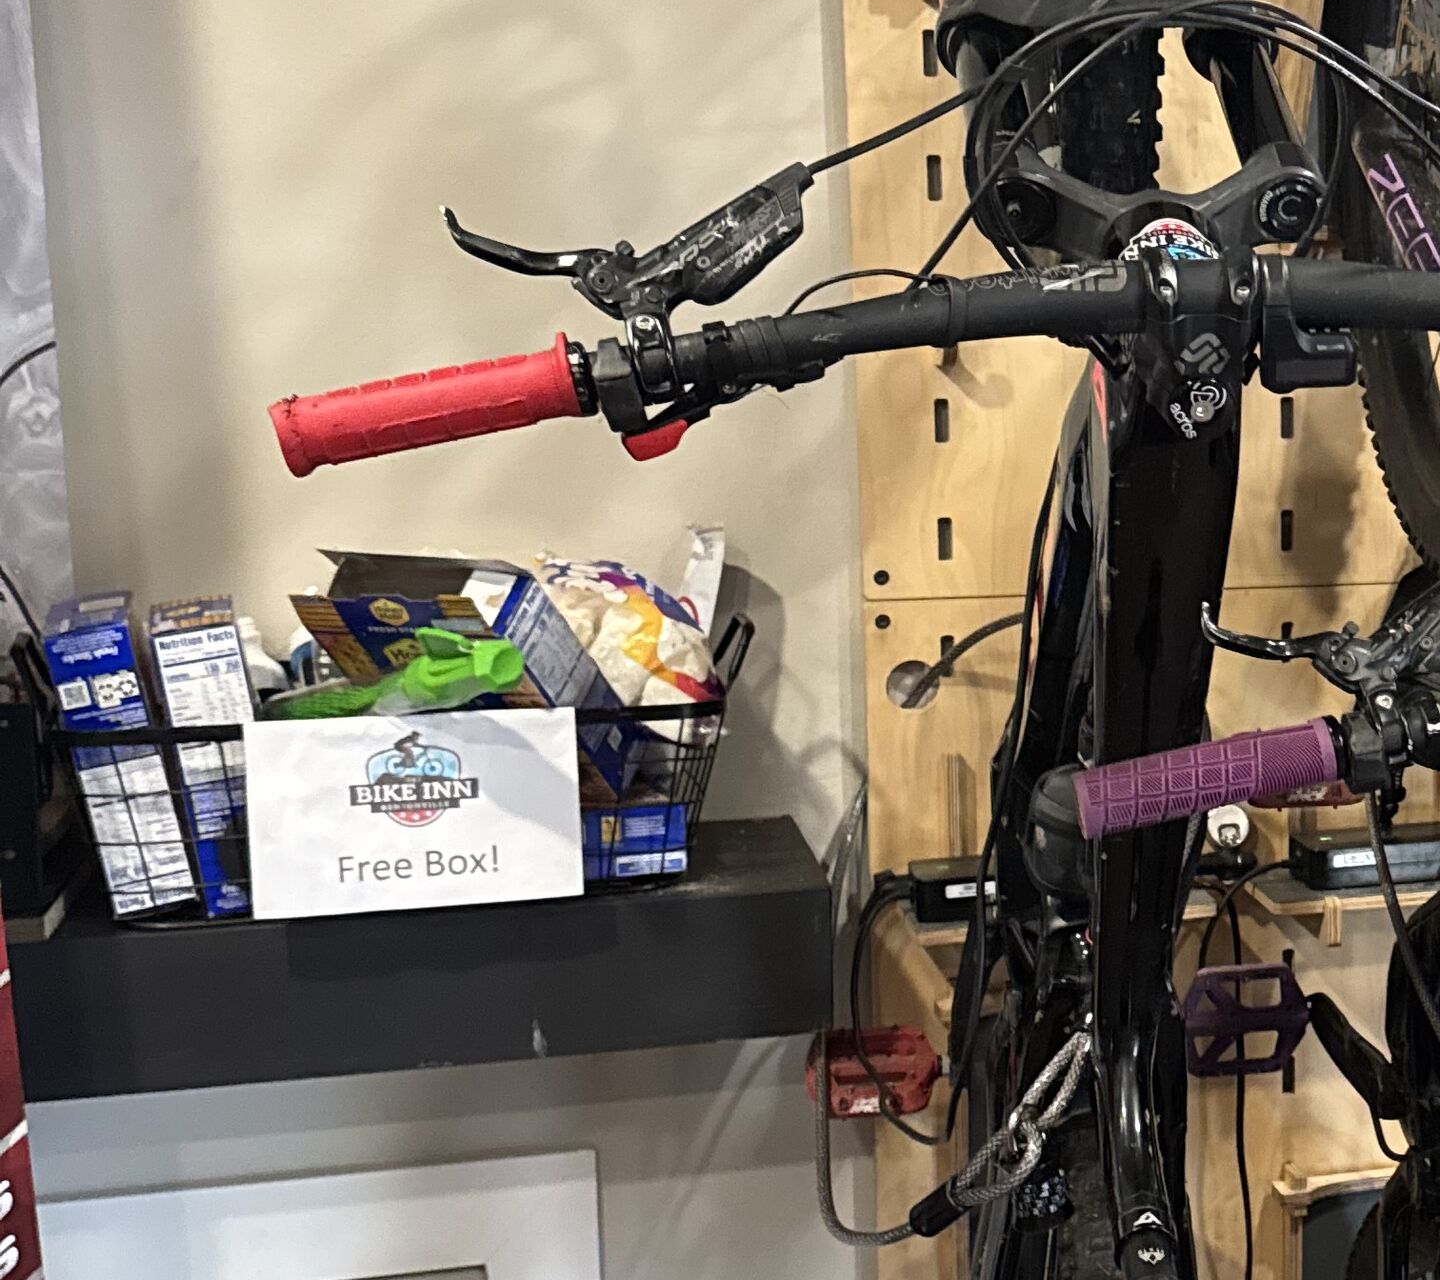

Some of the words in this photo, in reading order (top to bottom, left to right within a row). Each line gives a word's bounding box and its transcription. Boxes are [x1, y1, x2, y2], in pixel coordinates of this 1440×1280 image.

[1168, 401, 1199, 440] acros
[158, 635, 204, 651] Nutrition
[206, 629, 235, 644] Facts
[355, 782, 417, 803] BIKE
[422, 780, 473, 800] INN
[338, 856, 413, 883] Free
[425, 844, 500, 878] Box!
